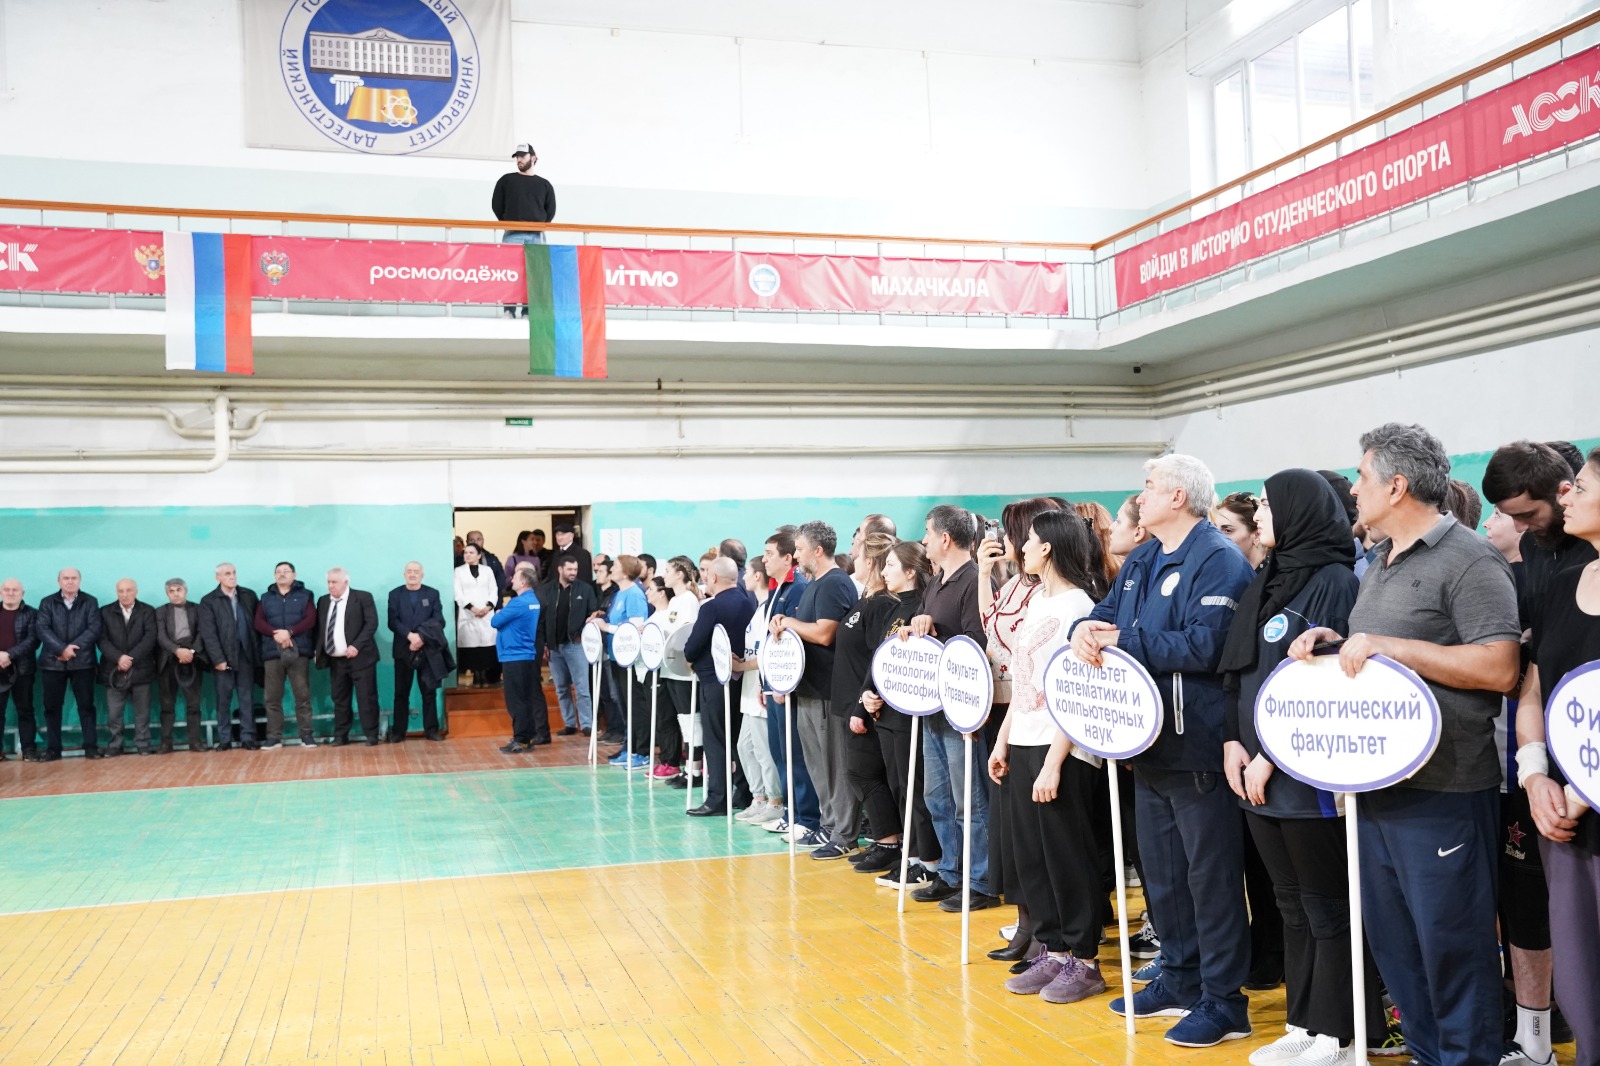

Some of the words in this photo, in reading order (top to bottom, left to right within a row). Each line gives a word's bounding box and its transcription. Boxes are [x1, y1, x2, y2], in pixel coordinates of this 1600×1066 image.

[282, 48, 378, 148] ДАГЕСТАНСКИЙ
[409, 56, 474, 147] УНИВЕРСИТЕТ
[1139, 251, 1178, 284] ВОЙДИ
[1180, 247, 1188, 269] В
[1191, 221, 1250, 265] ИСТОРИЮ
[1253, 170, 1378, 239] СТУДЕНЧЕСКОГО
[1382, 140, 1452, 191] СПОРТА
[871, 275, 990, 297] МАХАЧКАЛА
[890, 644, 939, 665] Факультет
[882, 662, 936, 682] психологии
[946, 657, 979, 681] Факультет
[1062, 656, 1127, 684] Факультет
[883, 677, 941, 701] философии
[944, 681, 980, 709] Управления
[1056, 678, 1128, 705] математики
[1132, 691, 1141, 707] и
[1055, 698, 1145, 730] компьютерных
[1265, 693, 1421, 720] Филологический
[1084, 724, 1114, 746] наук
[1291, 727, 1387, 759] факультет
